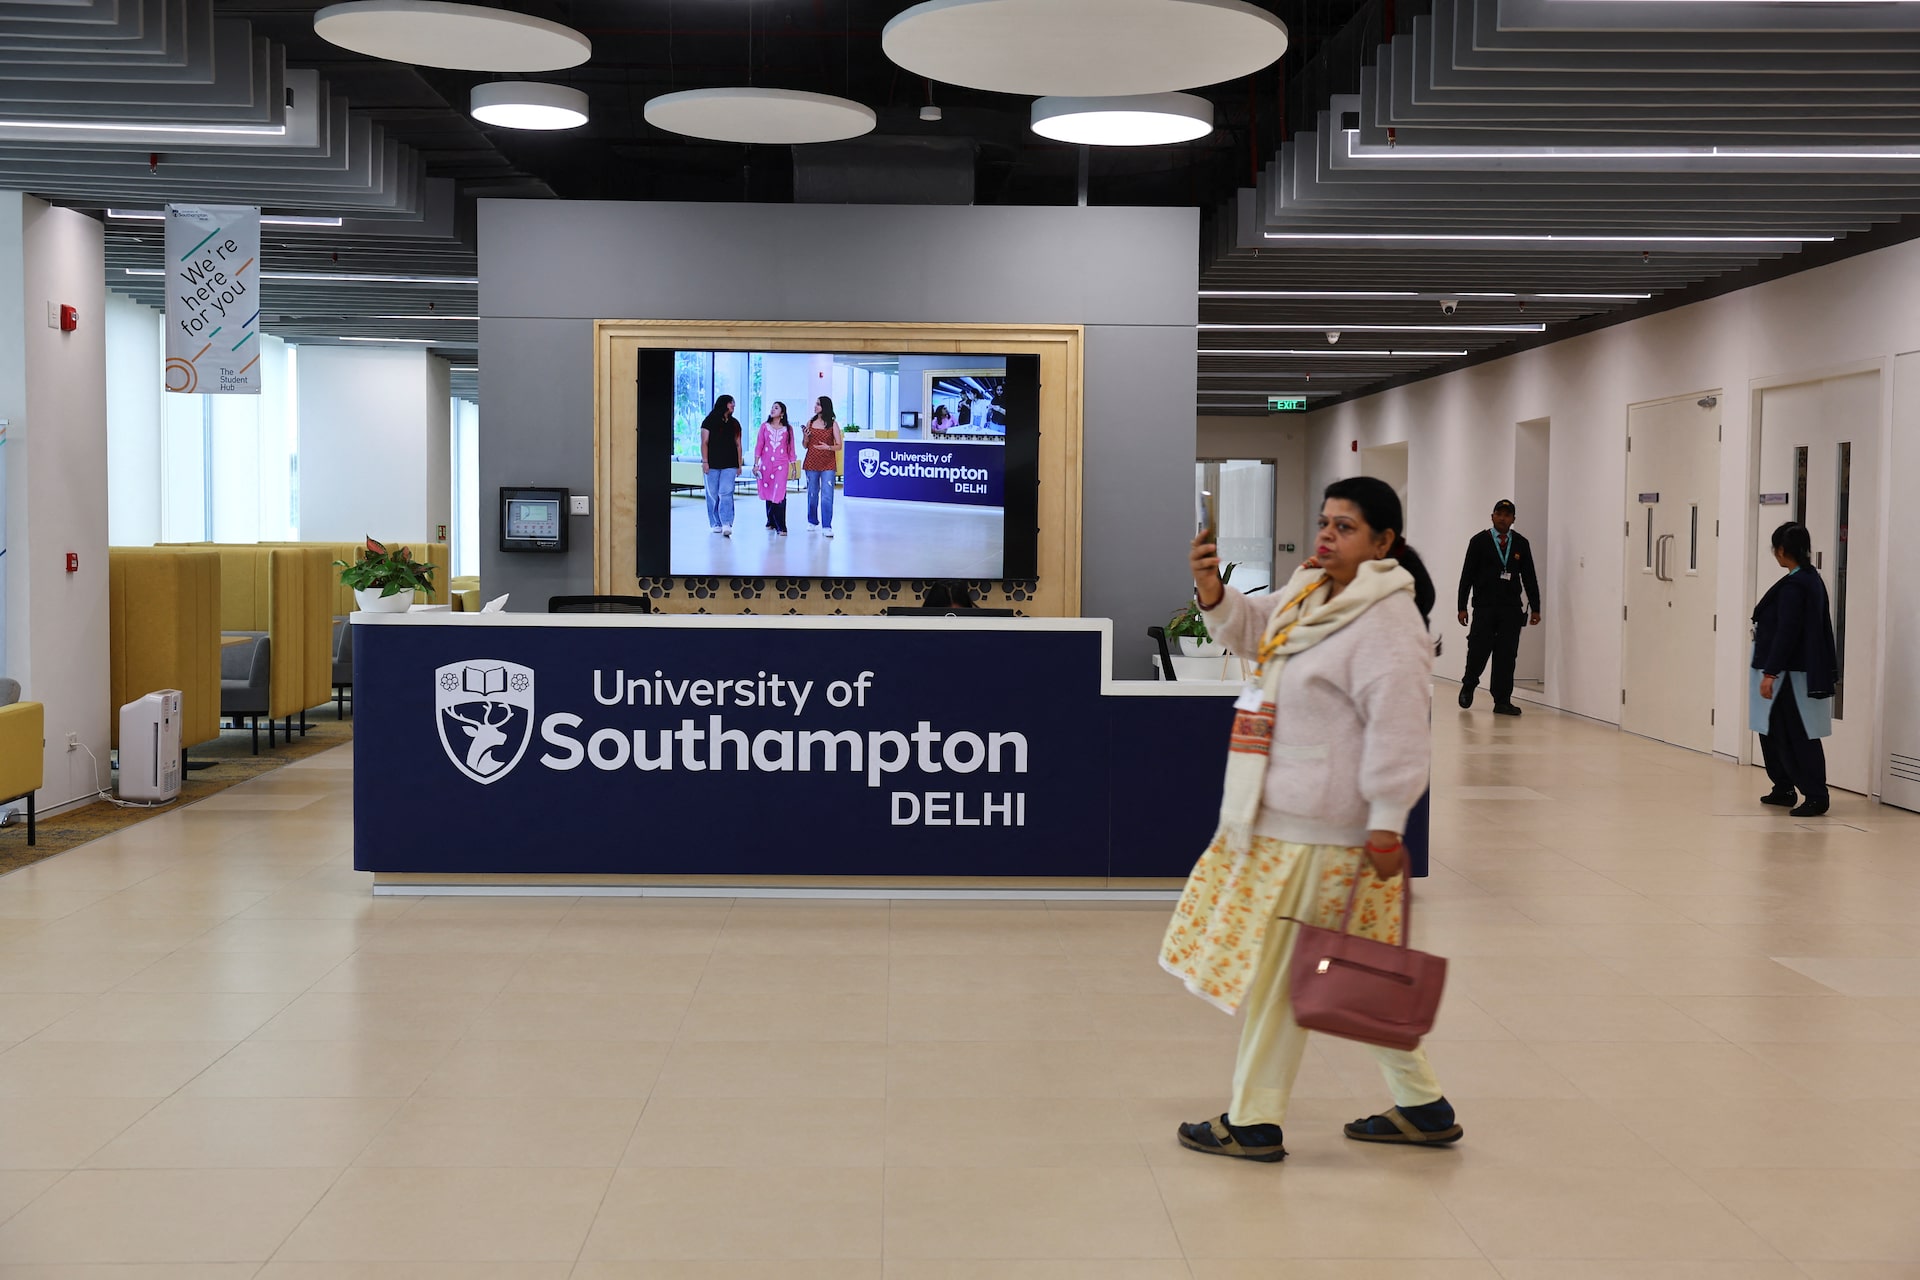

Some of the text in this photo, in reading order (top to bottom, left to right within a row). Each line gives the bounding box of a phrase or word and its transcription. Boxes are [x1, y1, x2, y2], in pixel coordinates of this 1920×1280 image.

[180, 239, 238, 286] We're
[180, 280, 246, 337] for you
[181, 272, 227, 311] here
[1277, 400, 1298, 410] EXIT
[879, 461, 988, 482] Southampton
[890, 451, 953, 464] University of
[954, 482, 987, 494] DELHI
[593, 669, 875, 716] University of
[540, 711, 1028, 788] Southampton
[891, 791, 1026, 827] DELHI
